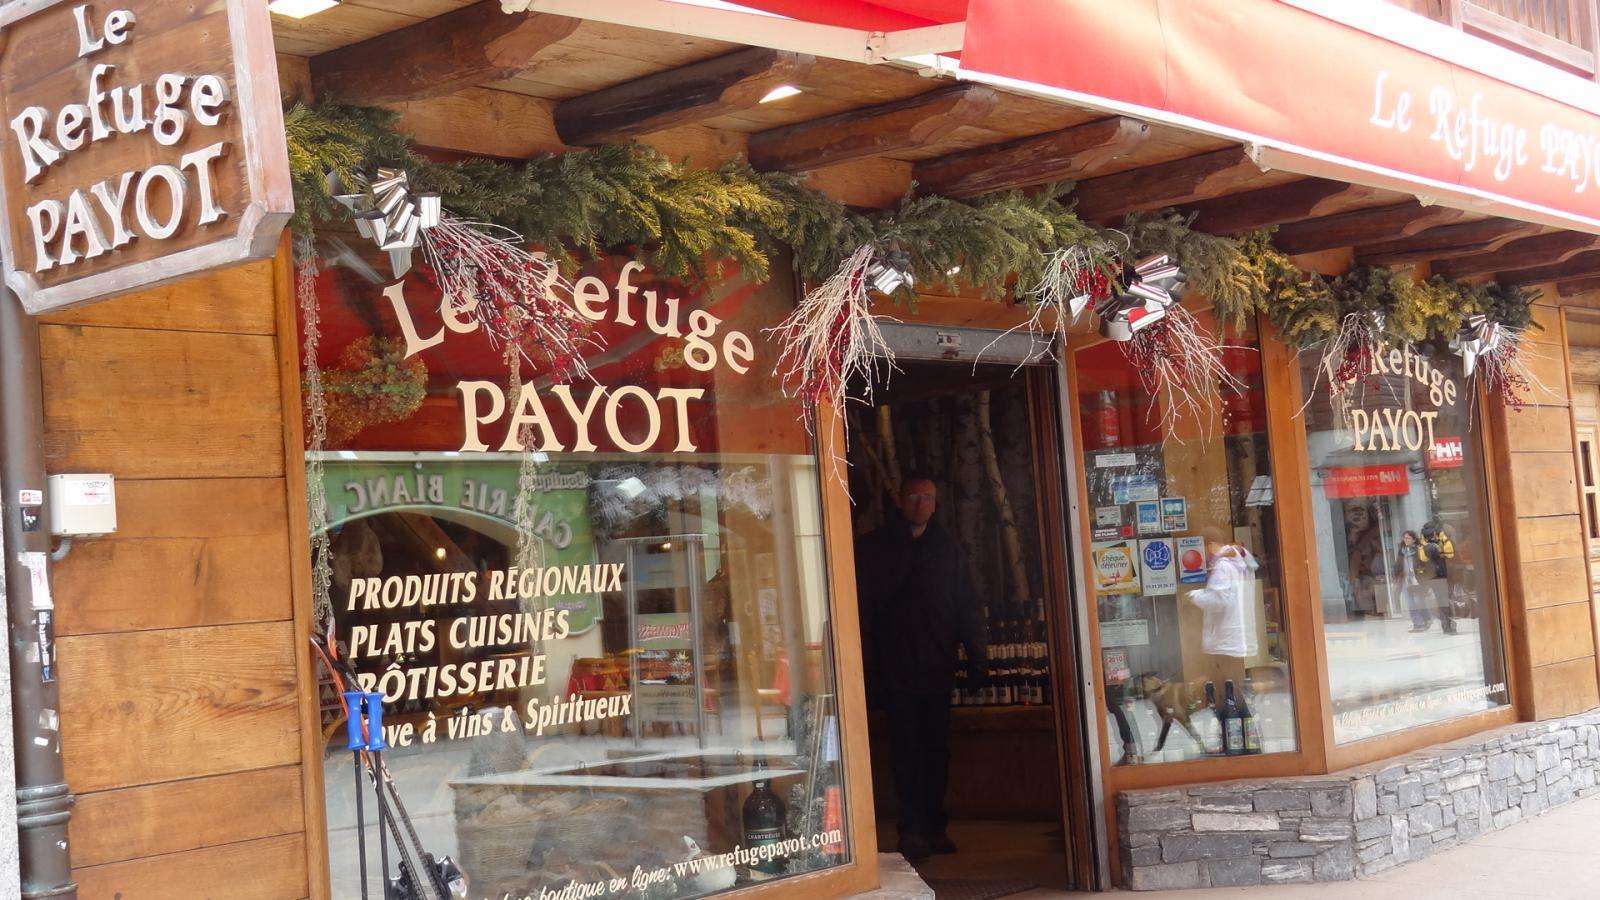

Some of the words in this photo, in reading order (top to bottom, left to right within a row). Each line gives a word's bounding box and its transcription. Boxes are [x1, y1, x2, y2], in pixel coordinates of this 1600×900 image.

[73, 4, 134, 57] Le
[10, 63, 229, 184] Refuge
[1370, 70, 1412, 132] Le
[1429, 84, 1528, 181] Refuge
[1540, 121, 1600, 193] PAY
[27, 141, 230, 272] PAYOT
[382, 279, 479, 360] Le
[456, 379, 706, 453] PAYOT
[1351, 407, 1438, 451] PAYOT
[347, 571, 477, 611] PRODUITS
[488, 563, 625, 601] RÉGIONAUX
[349, 619, 436, 659] PLATS
[449, 608, 570, 650] CUISINÉS
[357, 654, 547, 703] RÔTISSERIE
[422, 711, 436, 744] à
[447, 707, 493, 740] vins
[501, 705, 517, 733] &
[525, 694, 632, 736] Spiritueux
[541, 879, 605, 900] boutique
[609, 876, 628, 892] en
[632, 864, 671, 891] ligne:
[673, 828, 842, 878] www.refugepayot.com
